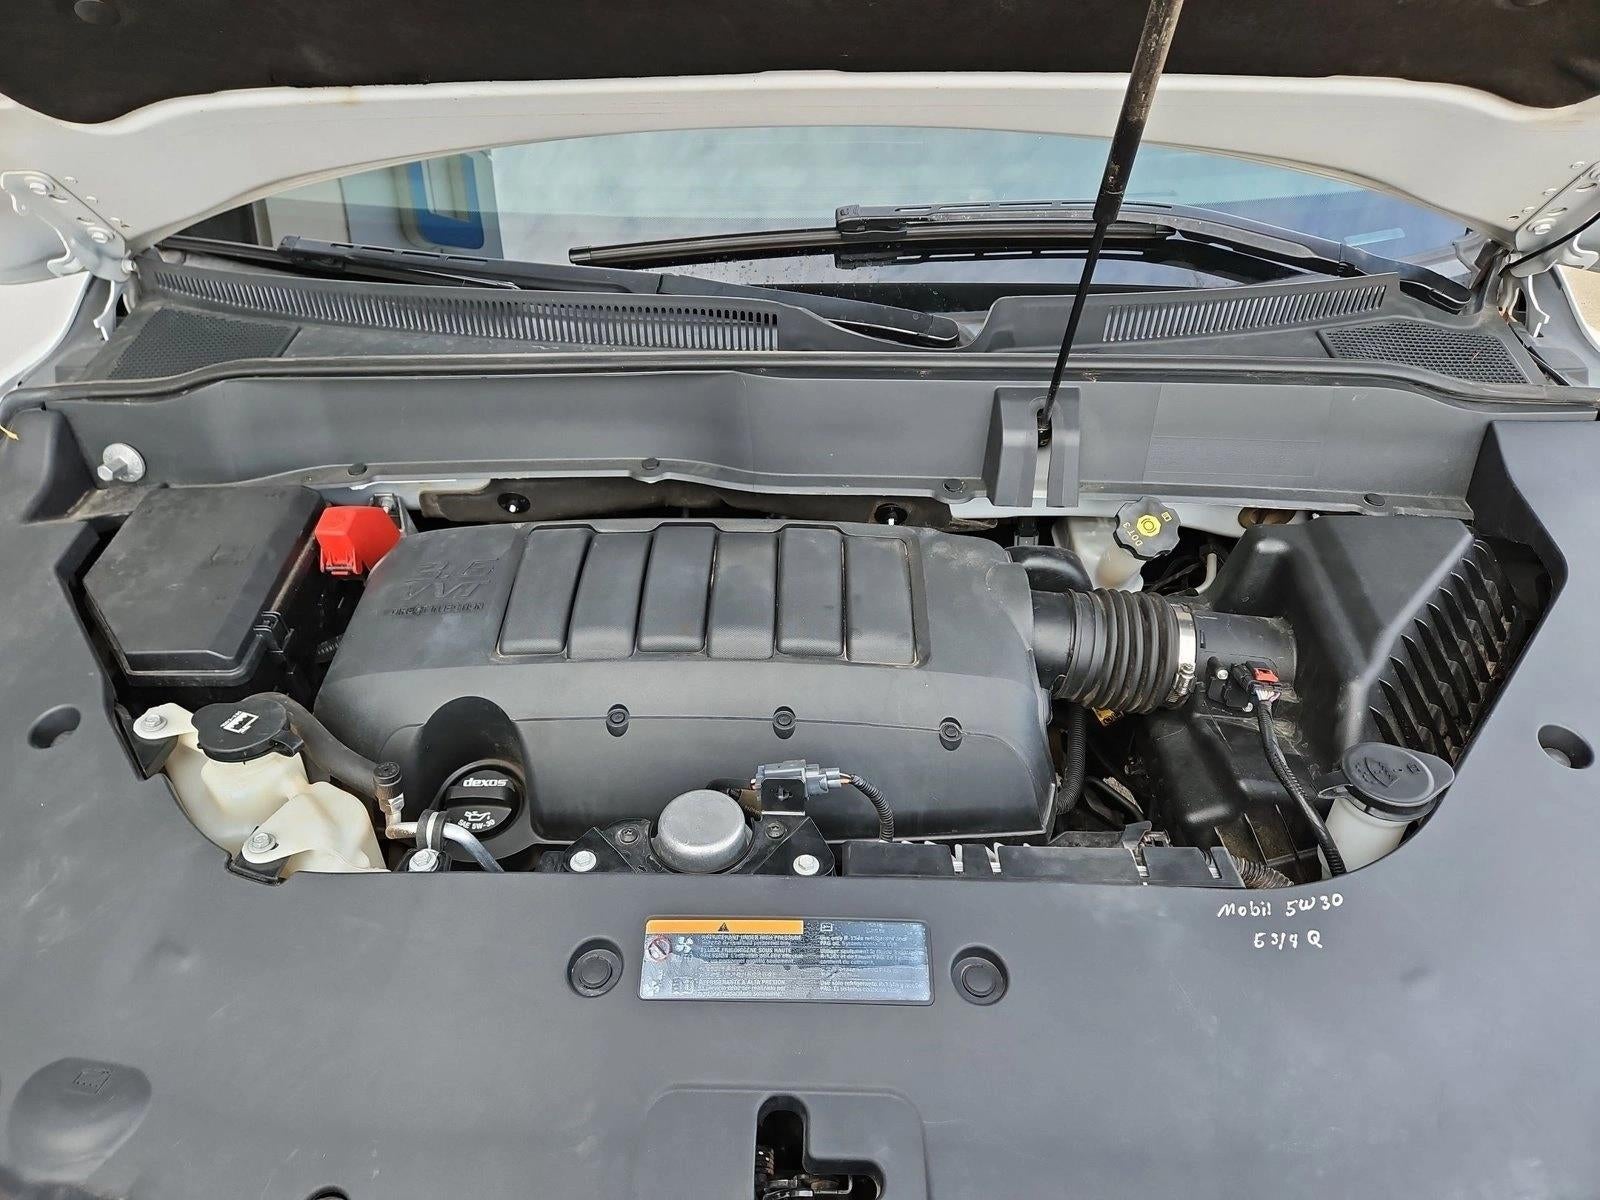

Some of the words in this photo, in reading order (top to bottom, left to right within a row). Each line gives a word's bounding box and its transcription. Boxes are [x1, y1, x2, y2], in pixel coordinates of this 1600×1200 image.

[462, 777, 508, 787] dexos
[457, 819, 471, 829] SAE
[471, 819, 496, 830] 5W-30
[1217, 900, 1272, 918] Mobil
[1307, 930, 1323, 949] Q
